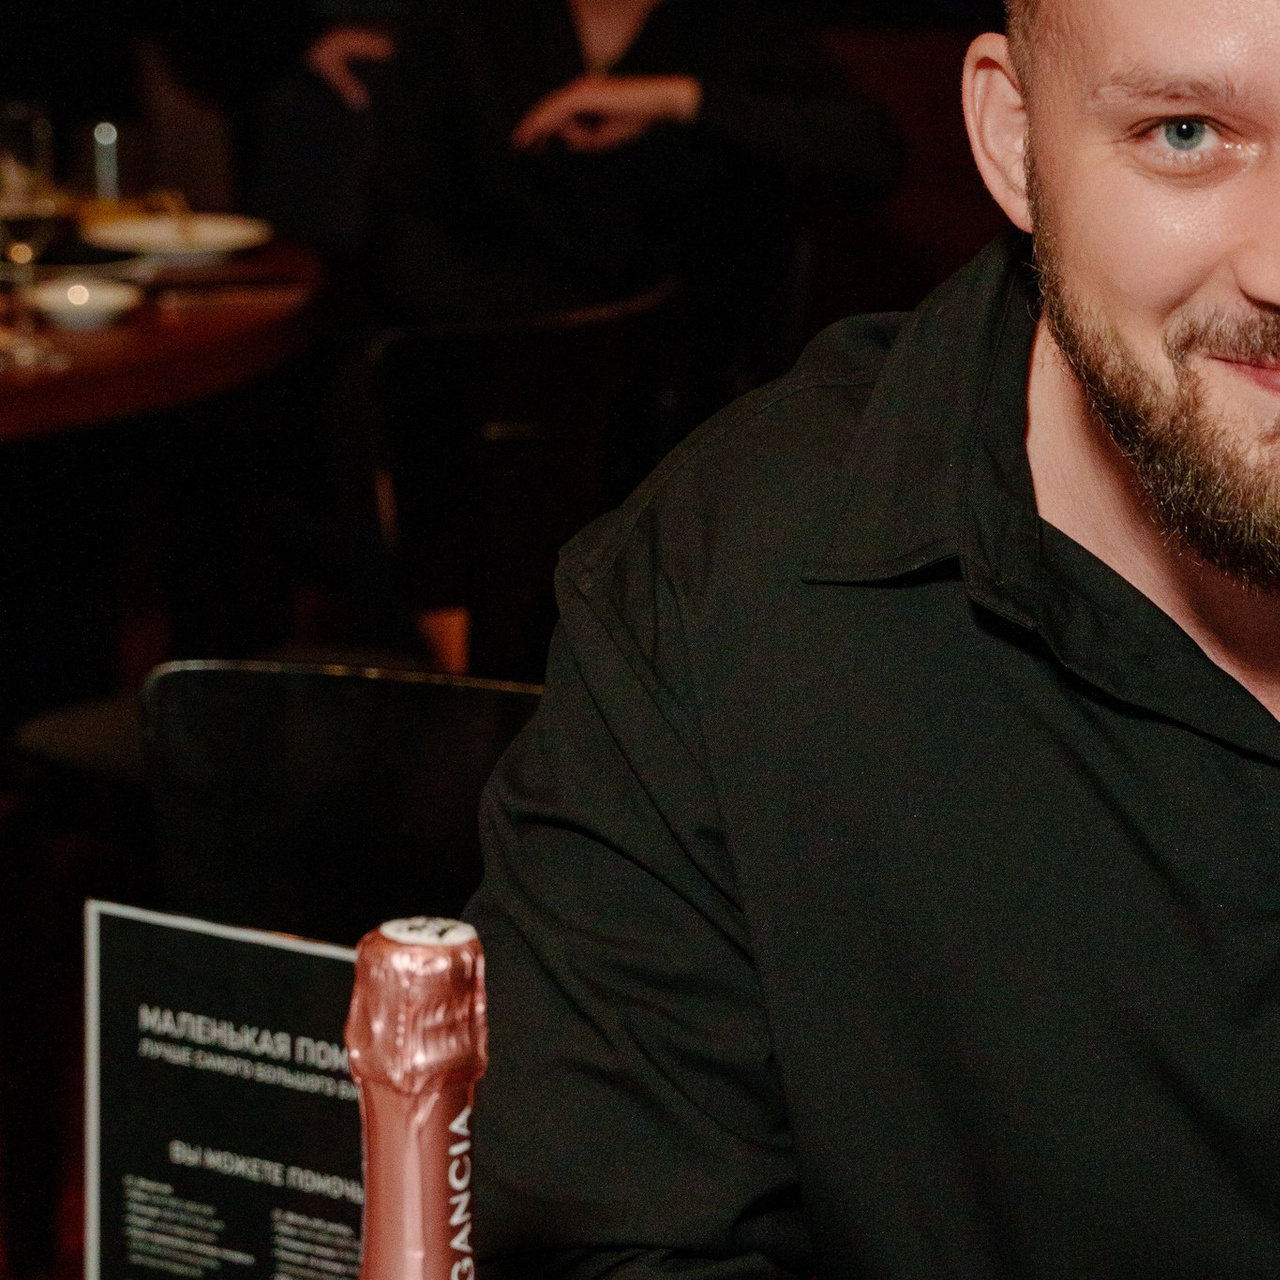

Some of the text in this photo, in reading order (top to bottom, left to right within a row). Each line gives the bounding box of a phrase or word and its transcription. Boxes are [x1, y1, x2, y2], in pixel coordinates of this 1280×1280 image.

[138, 1003, 291, 1062] МАЛЕНЬКАЯ
[168, 1139, 201, 1168] ВЫ
[203, 1147, 286, 1187] МОЖЕТЕ
